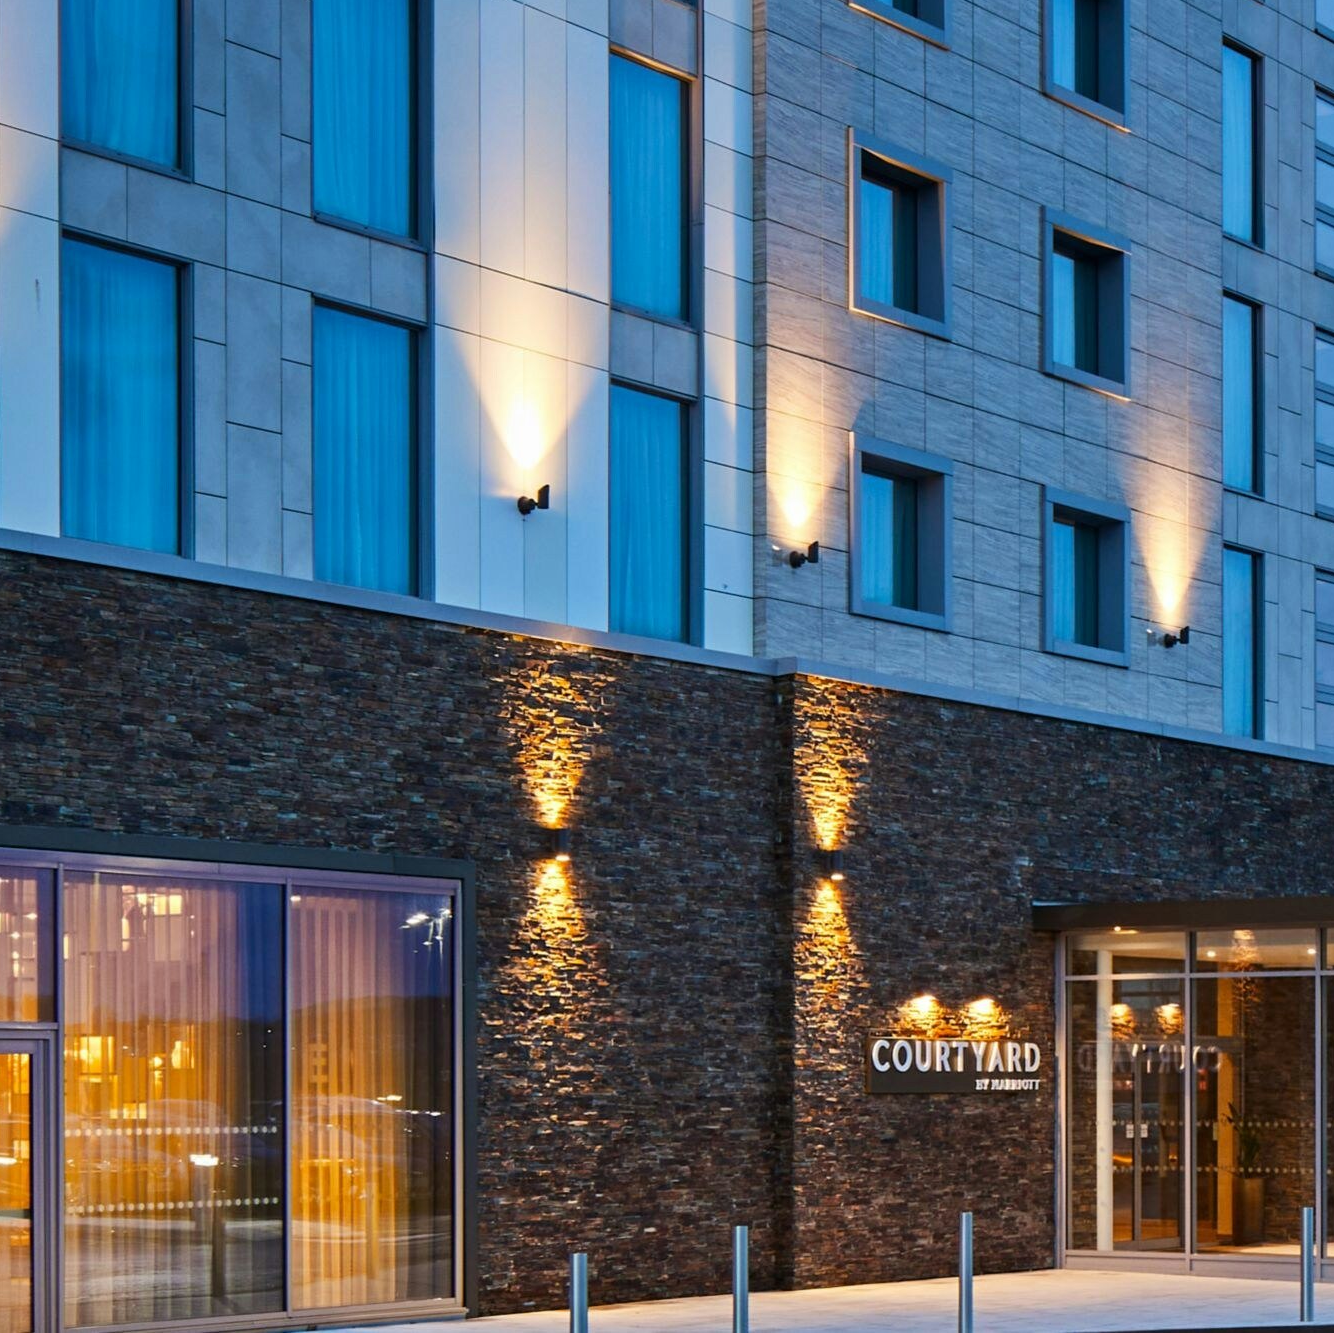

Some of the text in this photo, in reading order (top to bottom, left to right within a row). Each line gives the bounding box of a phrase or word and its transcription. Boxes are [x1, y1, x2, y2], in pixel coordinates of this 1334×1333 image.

[872, 1039, 1041, 1073] COURTYARD
[975, 1079, 1041, 1091] BY MARRIOTT
